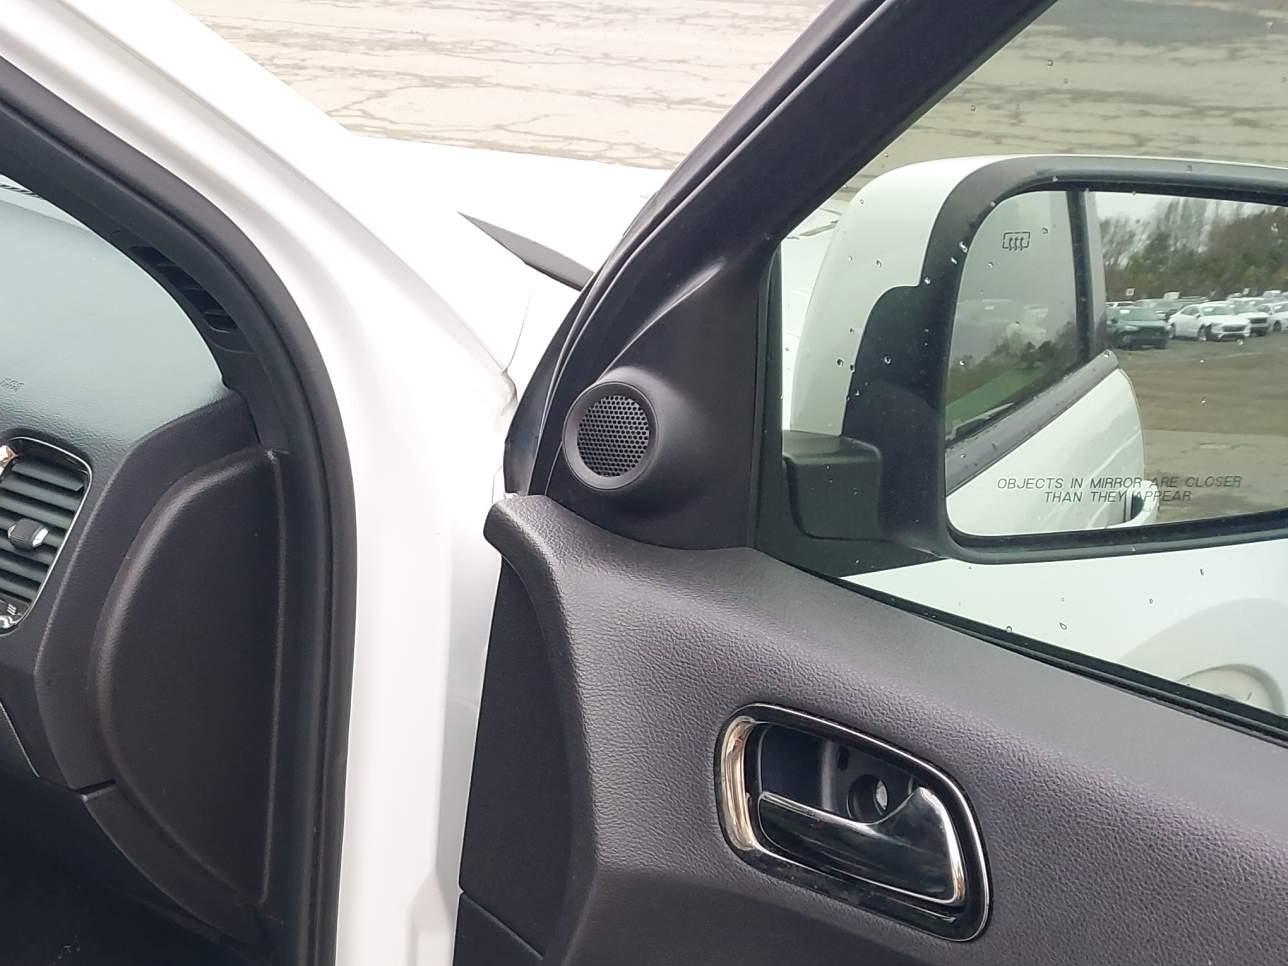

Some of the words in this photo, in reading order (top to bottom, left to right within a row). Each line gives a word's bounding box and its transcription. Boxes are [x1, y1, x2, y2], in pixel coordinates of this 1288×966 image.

[997, 477, 1063, 489] OBJECTS
[1070, 477, 1083, 489] IN
[1089, 477, 1142, 488] MIRROR
[1150, 477, 1178, 488] ARE
[1184, 475, 1241, 488] CLOSER
[1045, 491, 1082, 502] THAN
[1090, 491, 1126, 502] THEY
[1131, 490, 1192, 501] APPEAR
